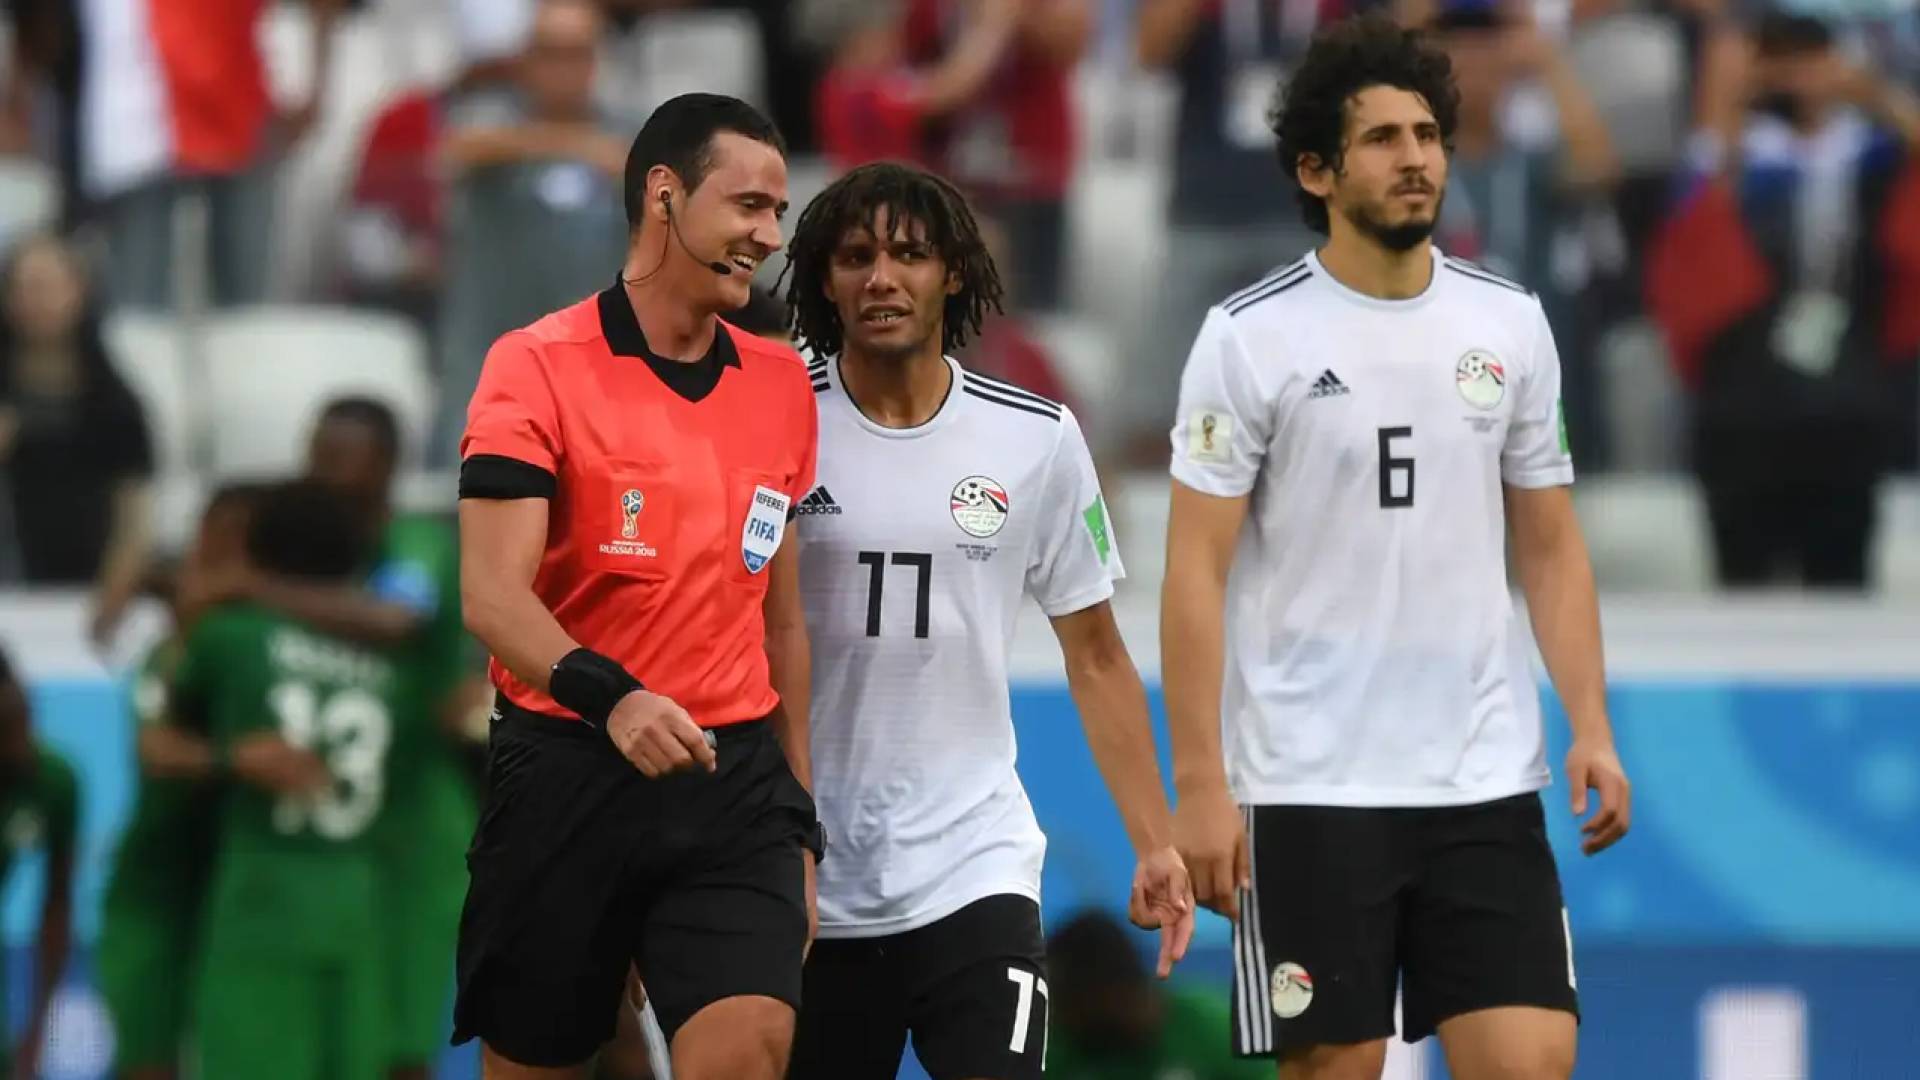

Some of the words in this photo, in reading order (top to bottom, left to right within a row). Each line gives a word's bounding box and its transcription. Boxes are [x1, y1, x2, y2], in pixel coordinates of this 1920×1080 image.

[1378, 426, 1415, 509] 6
[756, 491, 785, 512] REFEREE
[796, 503, 842, 514] adidas
[747, 517, 775, 543] FIFA
[599, 544, 632, 555] RUSSIA
[633, 546, 657, 557] 2018
[858, 550, 933, 639] 17
